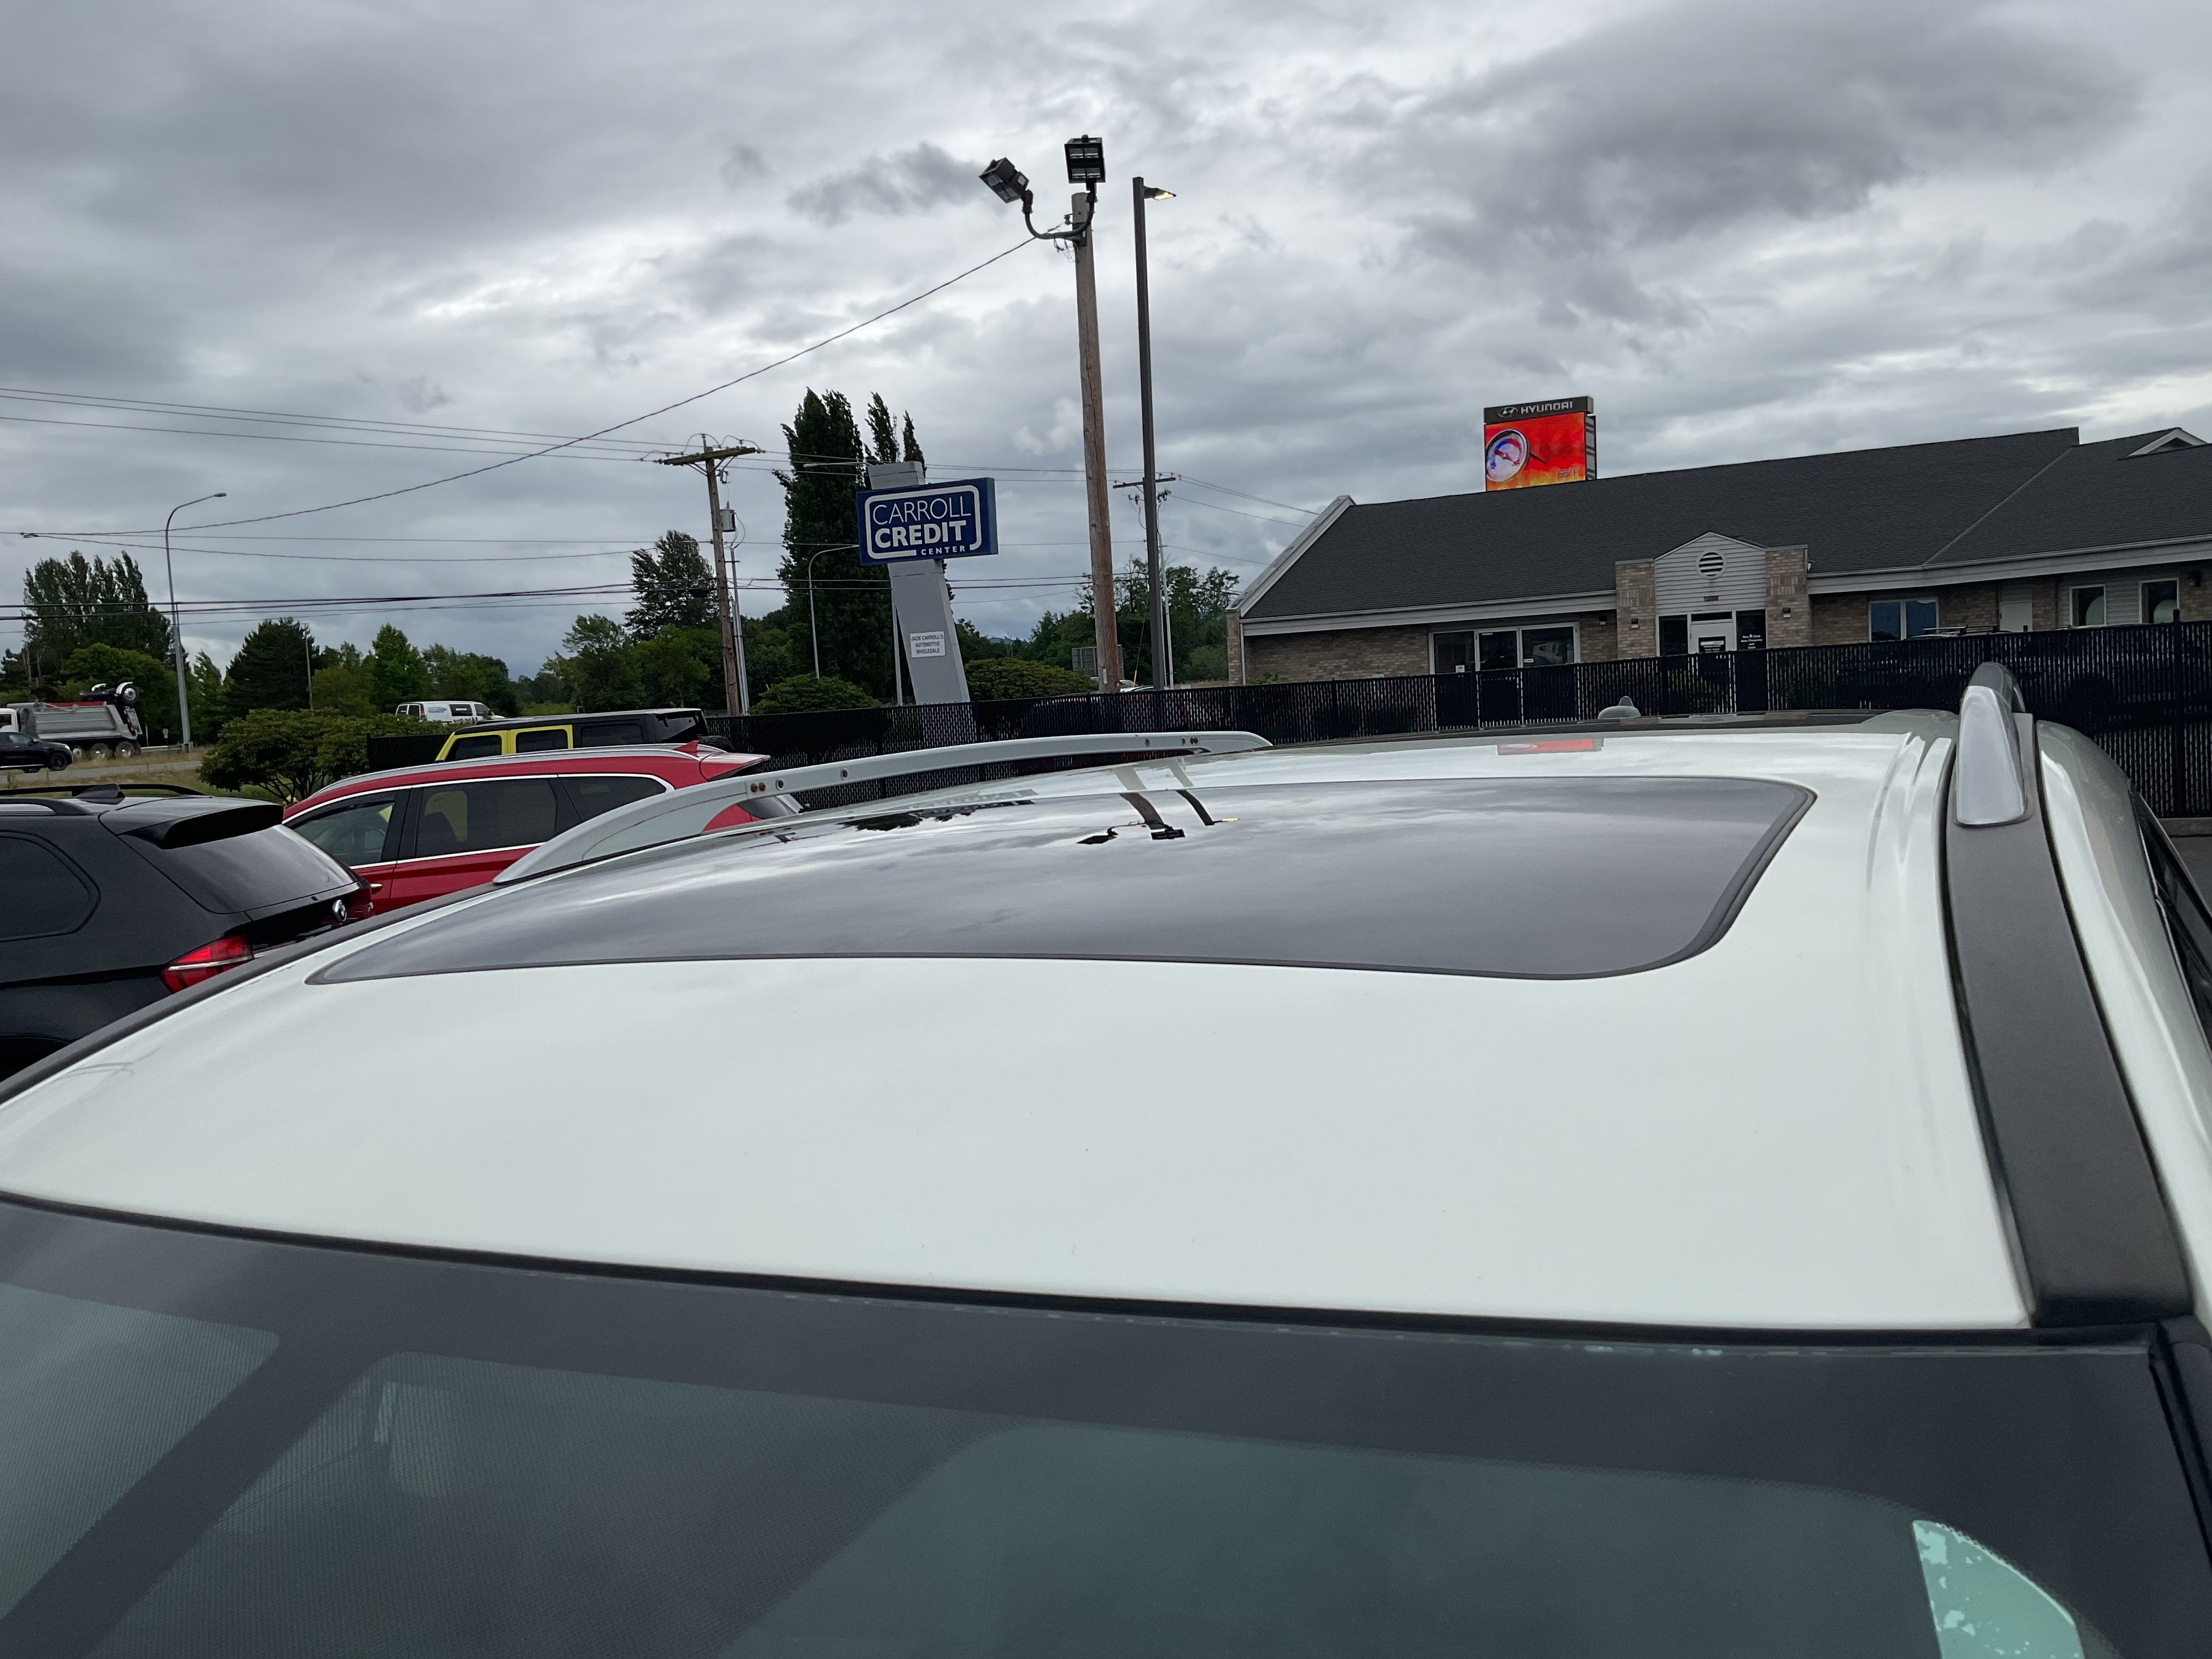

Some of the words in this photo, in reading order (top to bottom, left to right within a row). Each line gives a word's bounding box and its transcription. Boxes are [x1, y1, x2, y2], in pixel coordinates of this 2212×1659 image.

[1521, 401, 1572, 414] HYUNDAI
[873, 496, 971, 524] CARROLL
[874, 520, 967, 548] CREDIT
[921, 545, 966, 556] CENTER
